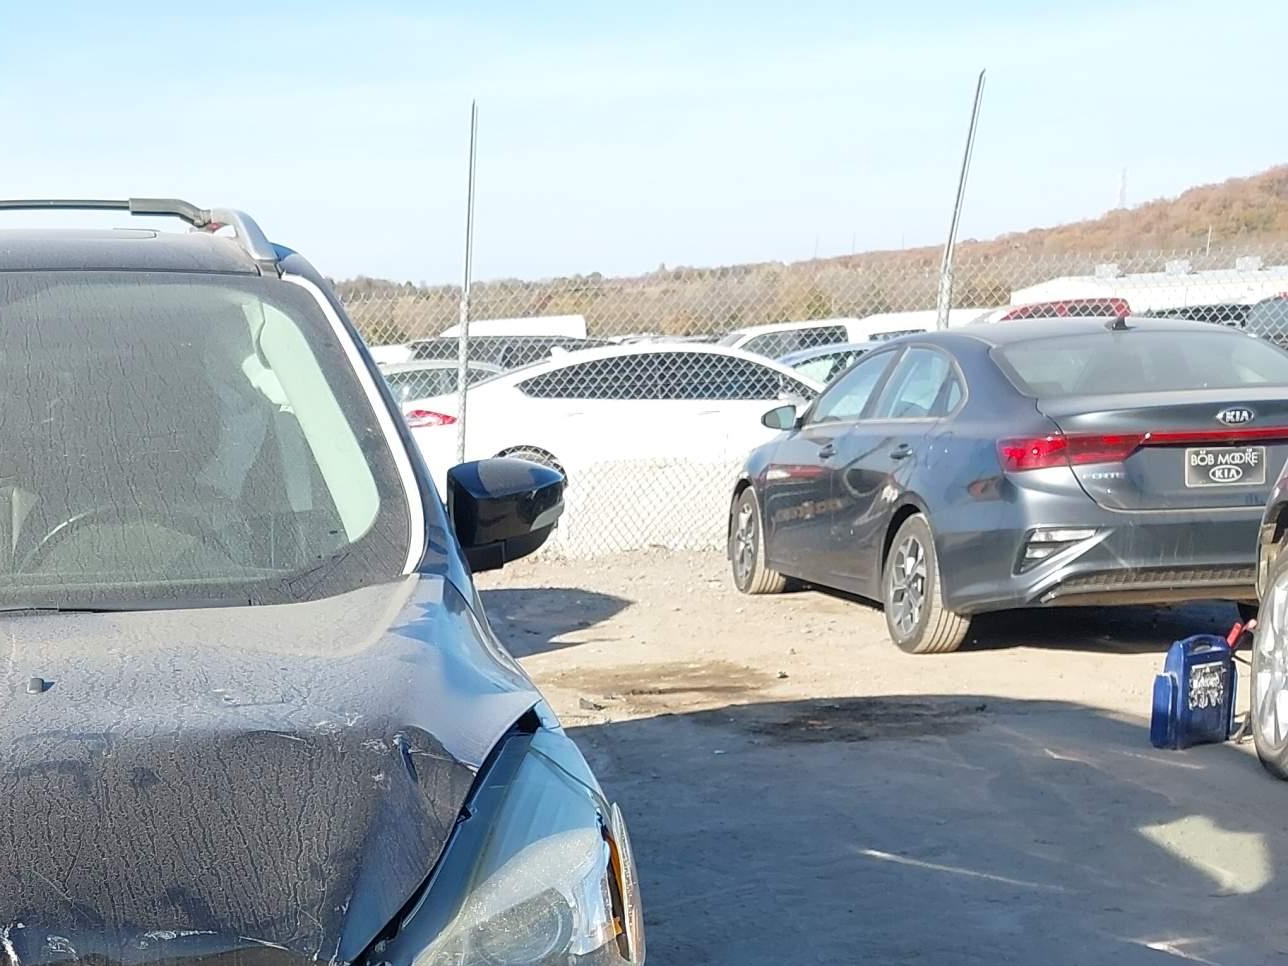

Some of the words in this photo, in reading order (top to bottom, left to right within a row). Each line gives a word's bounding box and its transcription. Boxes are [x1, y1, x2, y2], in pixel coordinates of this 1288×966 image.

[1225, 410, 1249, 422] KIA
[1217, 451, 1259, 467] MOORE
[1215, 468, 1238, 479] KIA
